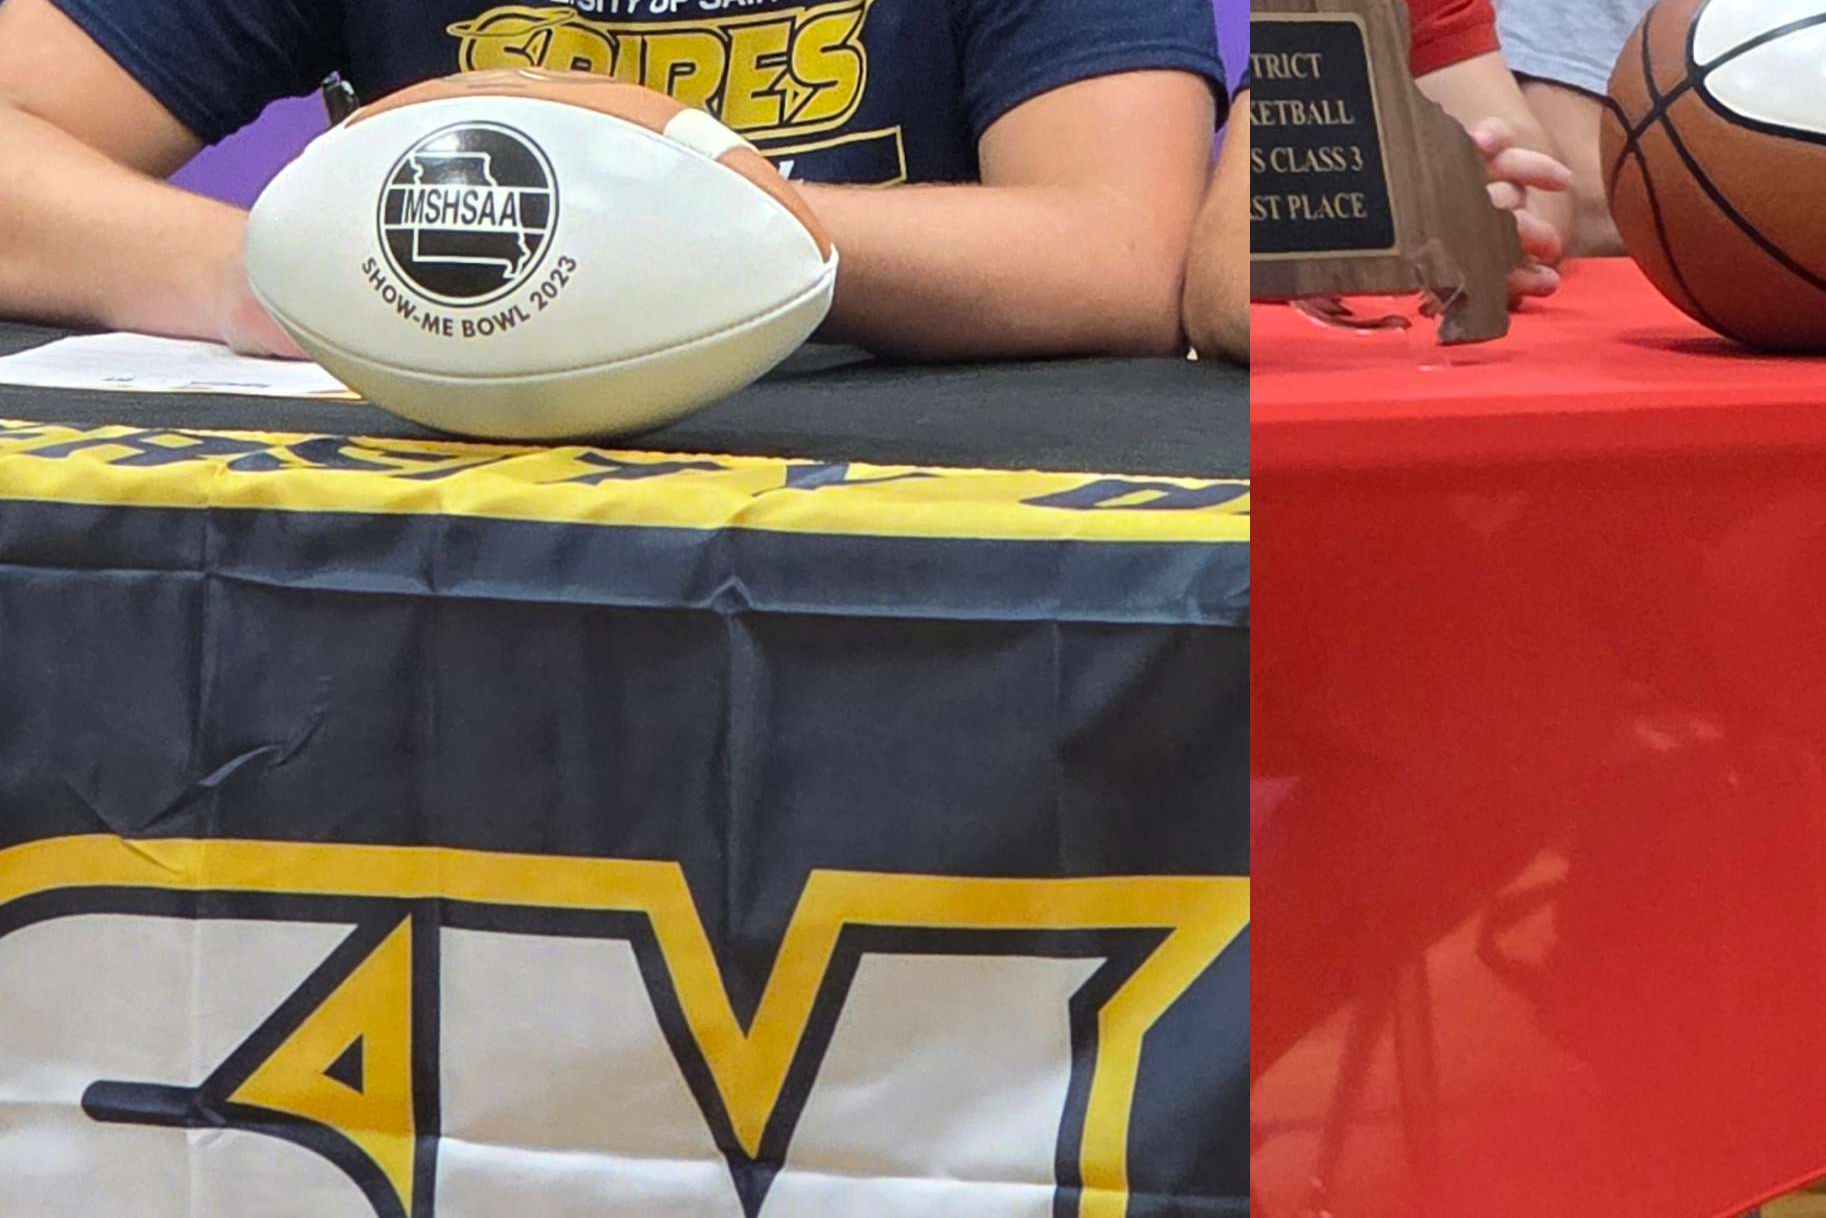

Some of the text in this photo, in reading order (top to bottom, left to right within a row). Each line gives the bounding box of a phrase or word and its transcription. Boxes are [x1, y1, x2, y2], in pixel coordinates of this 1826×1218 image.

[1270, 146, 1347, 173] CLASS
[1350, 146, 1363, 172] 3
[404, 188, 517, 227] MSHSAA
[1287, 192, 1367, 221] PLACE
[361, 255, 578, 338] SHOW-ME BOWL 2023
